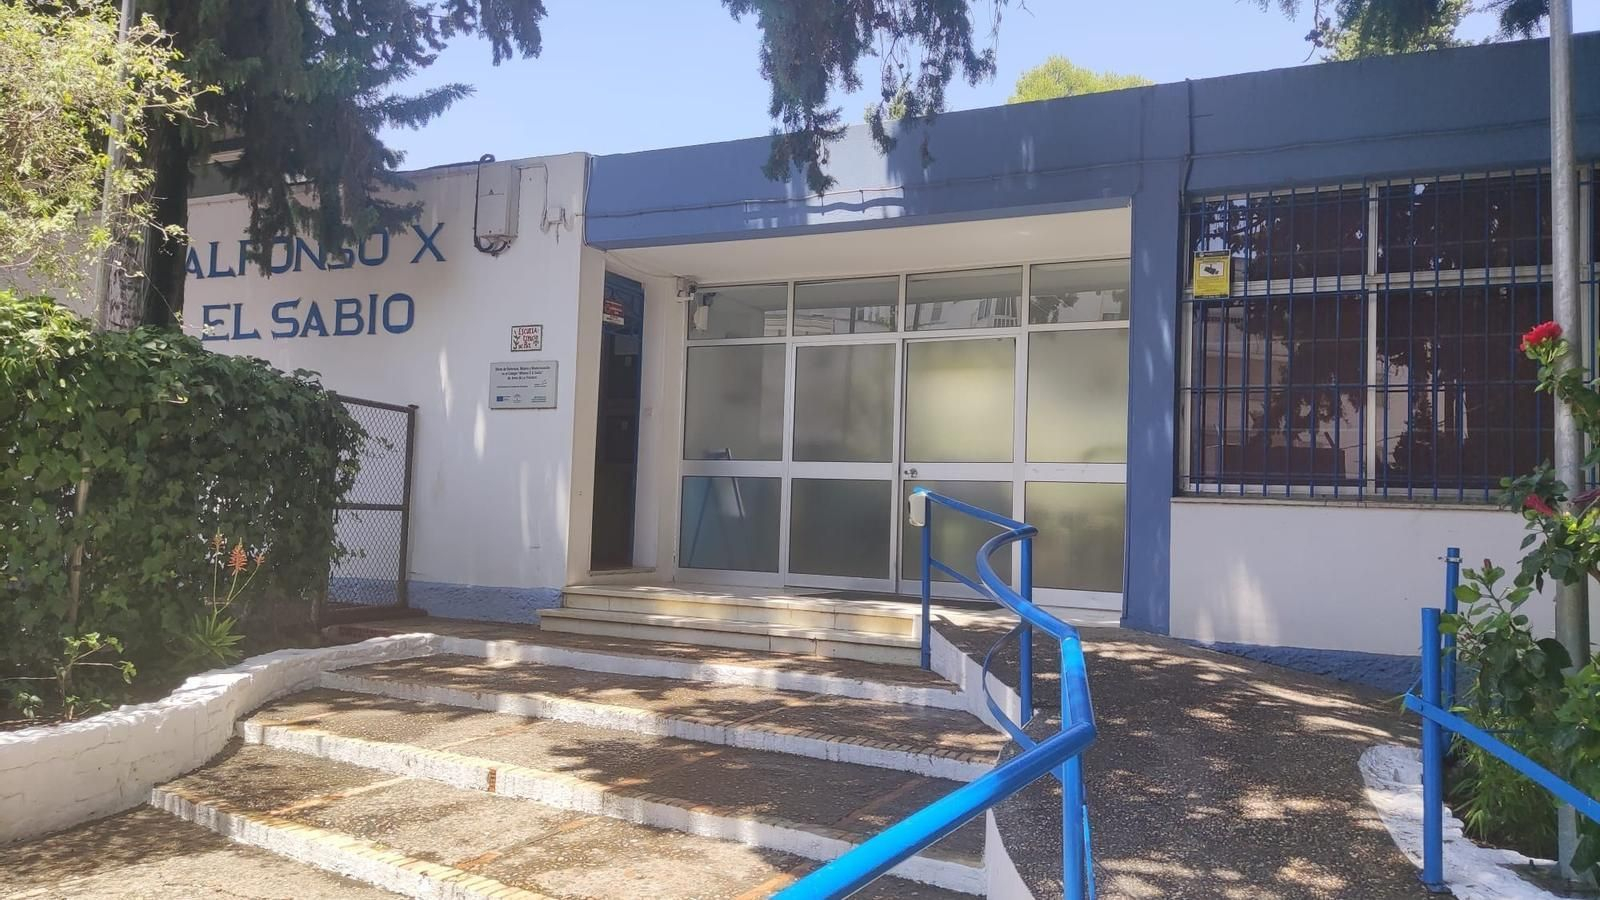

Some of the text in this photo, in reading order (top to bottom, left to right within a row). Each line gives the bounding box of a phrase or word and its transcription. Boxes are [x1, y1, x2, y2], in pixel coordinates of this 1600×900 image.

[409, 222, 447, 264] X
[200, 293, 415, 342] EL SABIO
